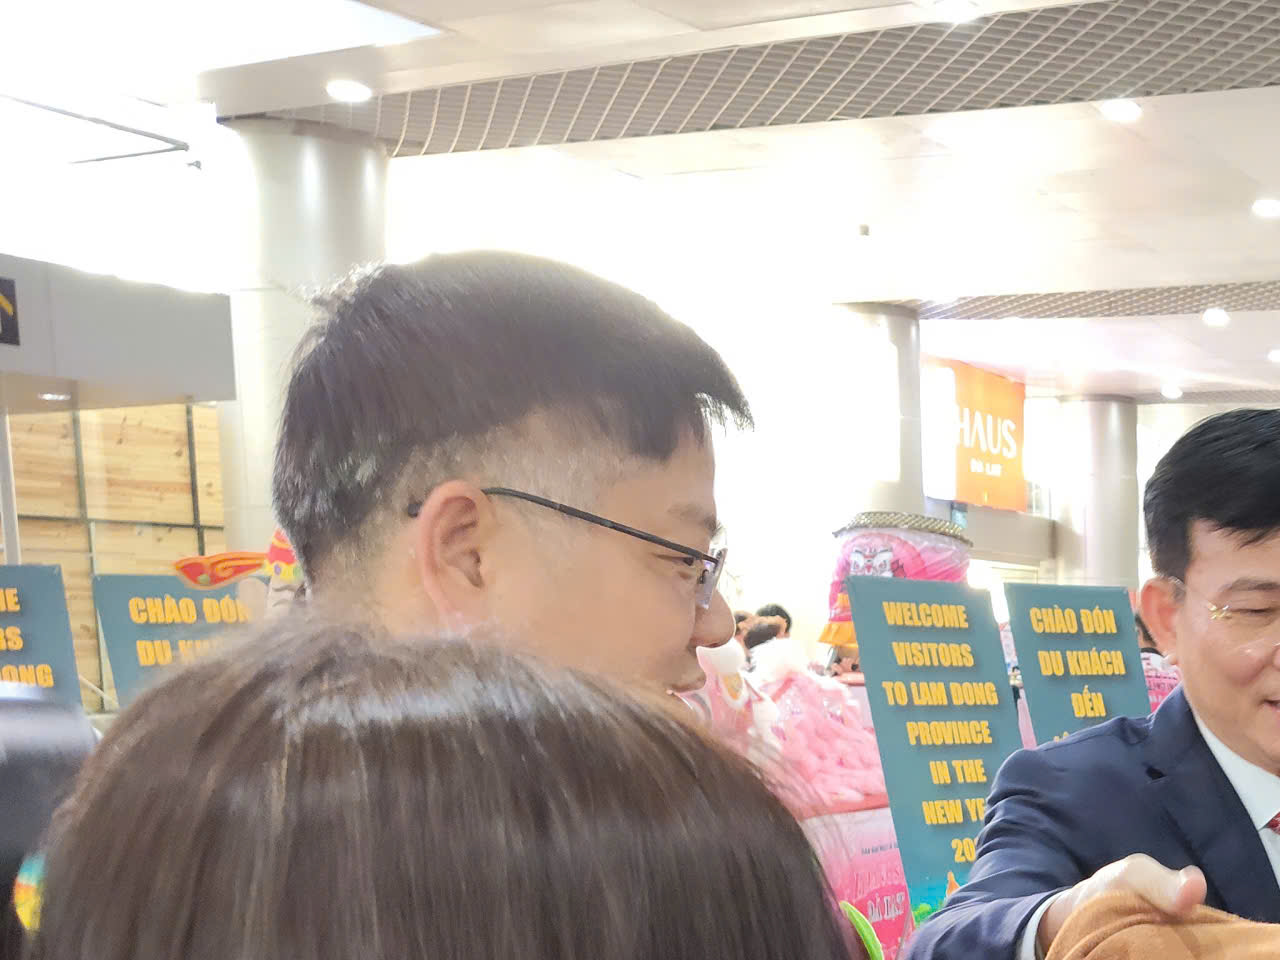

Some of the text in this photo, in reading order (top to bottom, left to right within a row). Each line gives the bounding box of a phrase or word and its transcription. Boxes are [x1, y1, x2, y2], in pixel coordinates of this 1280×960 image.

[957, 407, 1017, 459] HAUS
[128, 593, 197, 624] CHÀO
[882, 601, 969, 629] WELCOME
[1029, 604, 1118, 634] CHÀO ĐÓN
[136, 639, 173, 666] DU
[891, 641, 975, 668] VISITORS
[1038, 647, 1126, 676] DU KHÁCH
[0, 664, 55, 688] ONG
[882, 681, 999, 706] TO LAM DONG
[906, 720, 993, 745] PROVINCE
[929, 759, 987, 785] IN THE
[922, 798, 985, 825] NEW YE
[951, 837, 979, 863] 20
